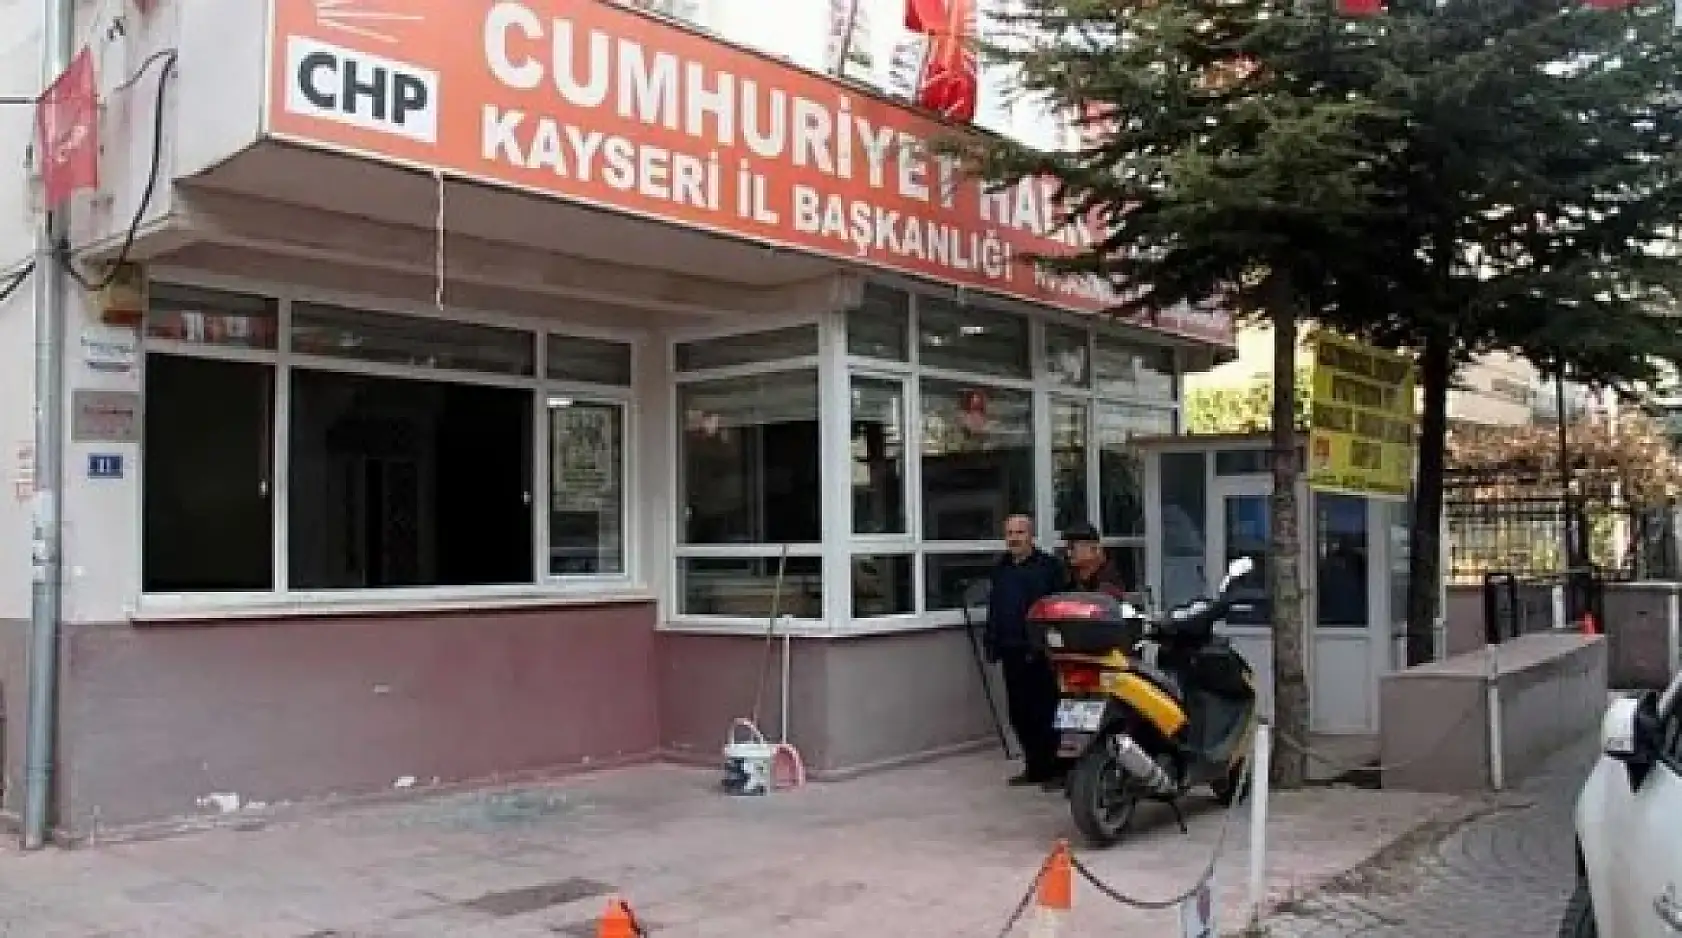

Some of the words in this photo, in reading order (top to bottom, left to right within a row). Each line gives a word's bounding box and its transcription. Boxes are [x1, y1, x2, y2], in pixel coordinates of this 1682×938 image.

[297, 51, 428, 125] CHP
[485, 1, 962, 208] CUMHURİYET
[482, 103, 720, 212] KAYSERİ
[737, 157, 780, 225] İL
[793, 184, 1012, 283] BAŞKANLIĞI
